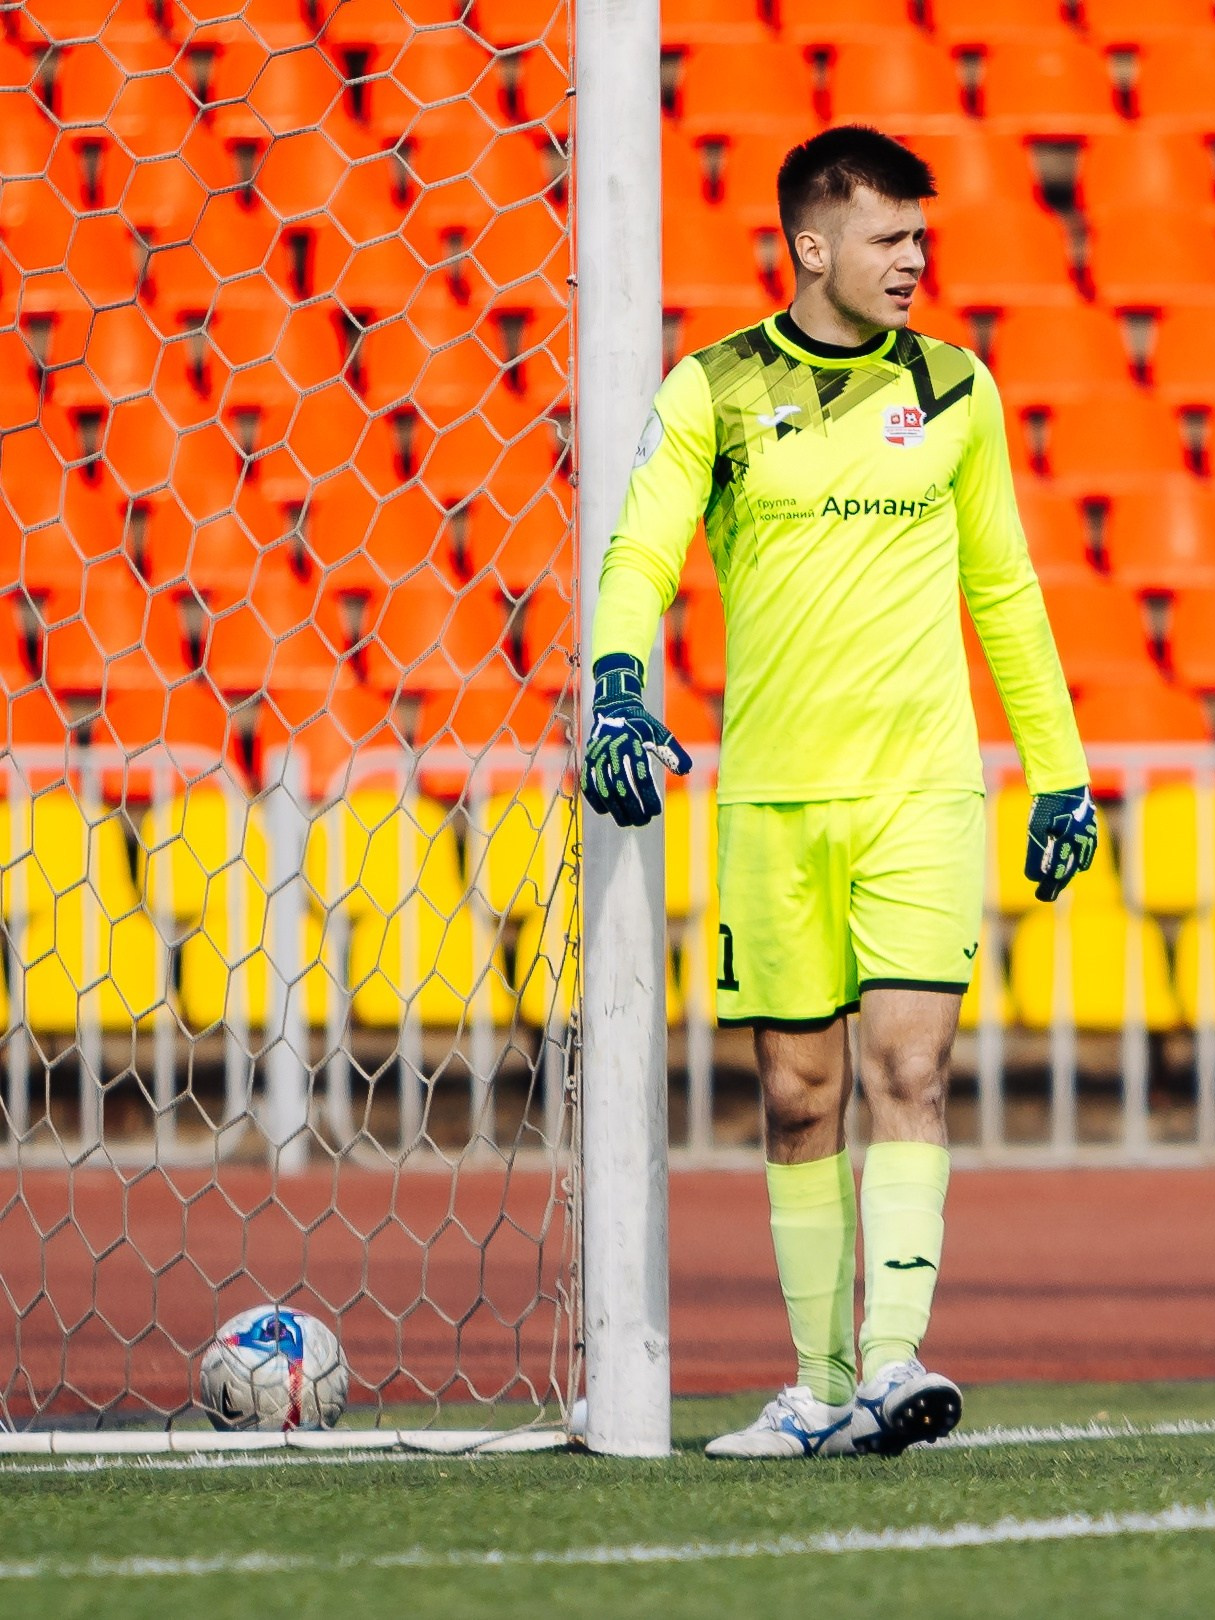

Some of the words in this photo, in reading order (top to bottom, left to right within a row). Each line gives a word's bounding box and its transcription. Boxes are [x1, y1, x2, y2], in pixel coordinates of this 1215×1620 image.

[757, 498, 797, 509] Группа
[821, 496, 928, 520] Ариант
[759, 509, 815, 521] компаний
